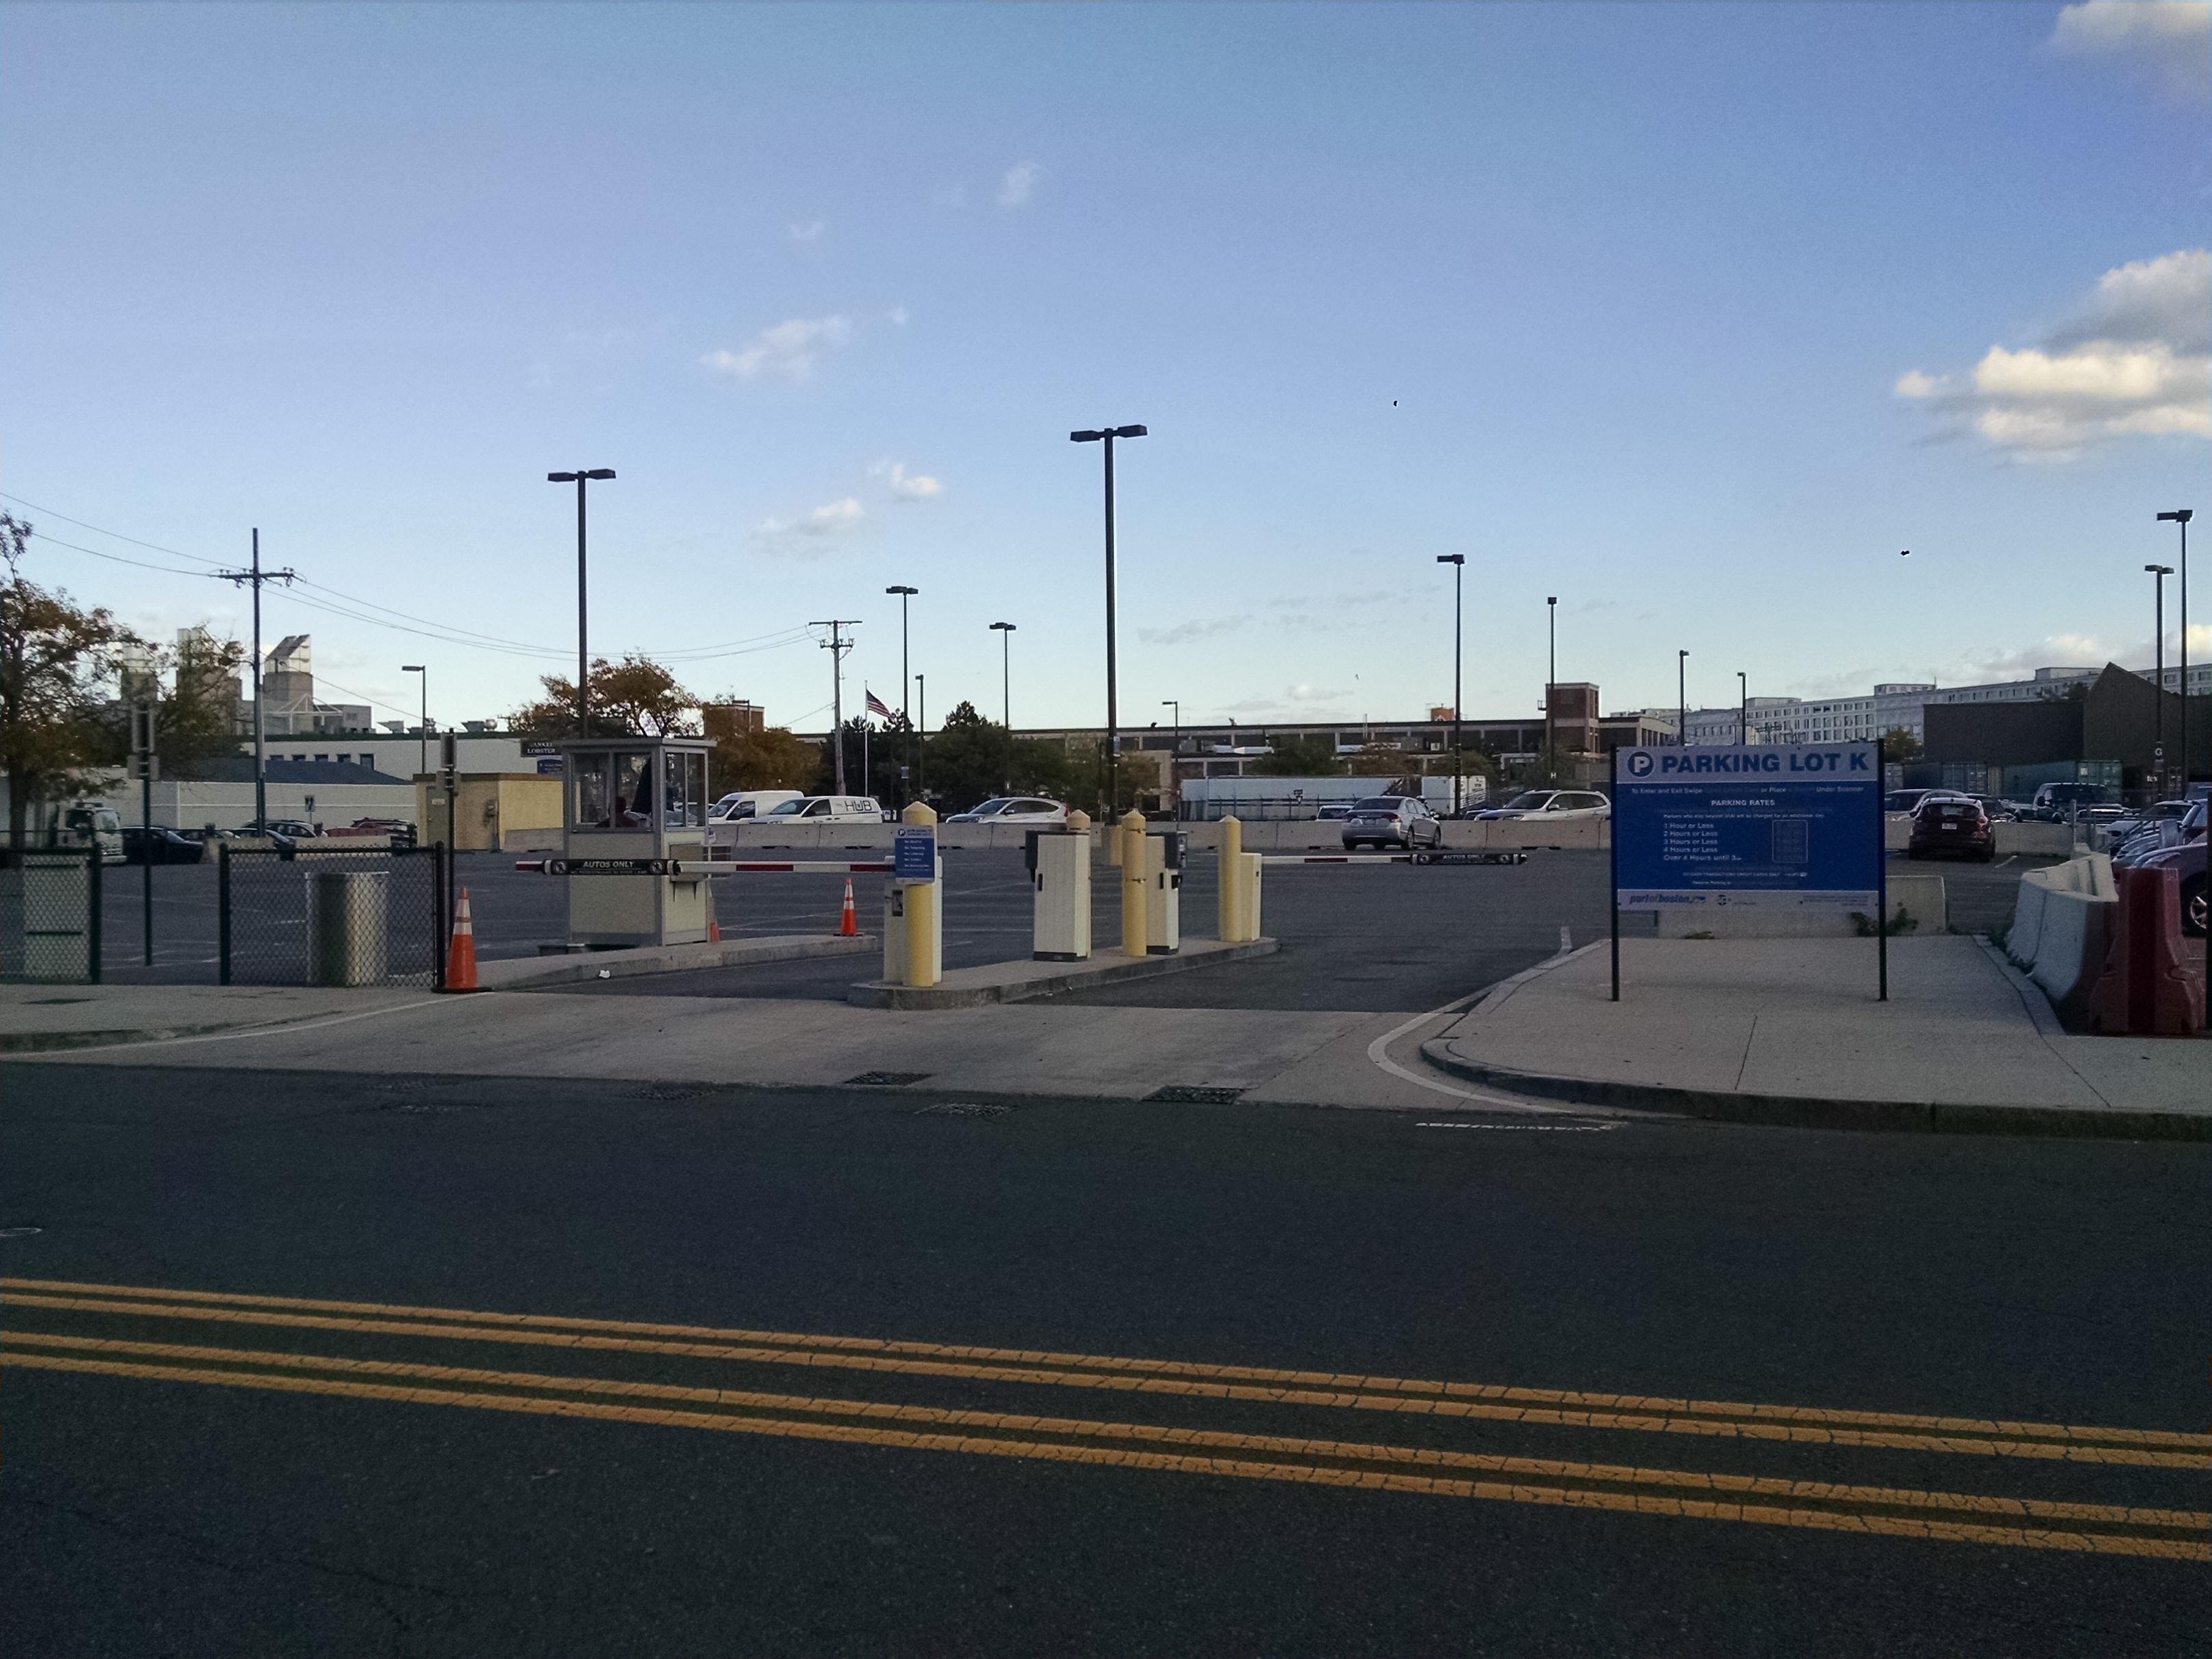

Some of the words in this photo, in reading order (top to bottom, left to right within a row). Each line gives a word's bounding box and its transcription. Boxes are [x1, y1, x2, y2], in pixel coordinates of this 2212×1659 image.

[2155, 747, 2163, 756] G
[1634, 756, 1650, 773] P
[1662, 754, 1780, 773] PARKING
[1790, 754, 1840, 771] LOT
[1851, 753, 1868, 771] K
[845, 800, 872, 812] HUB
